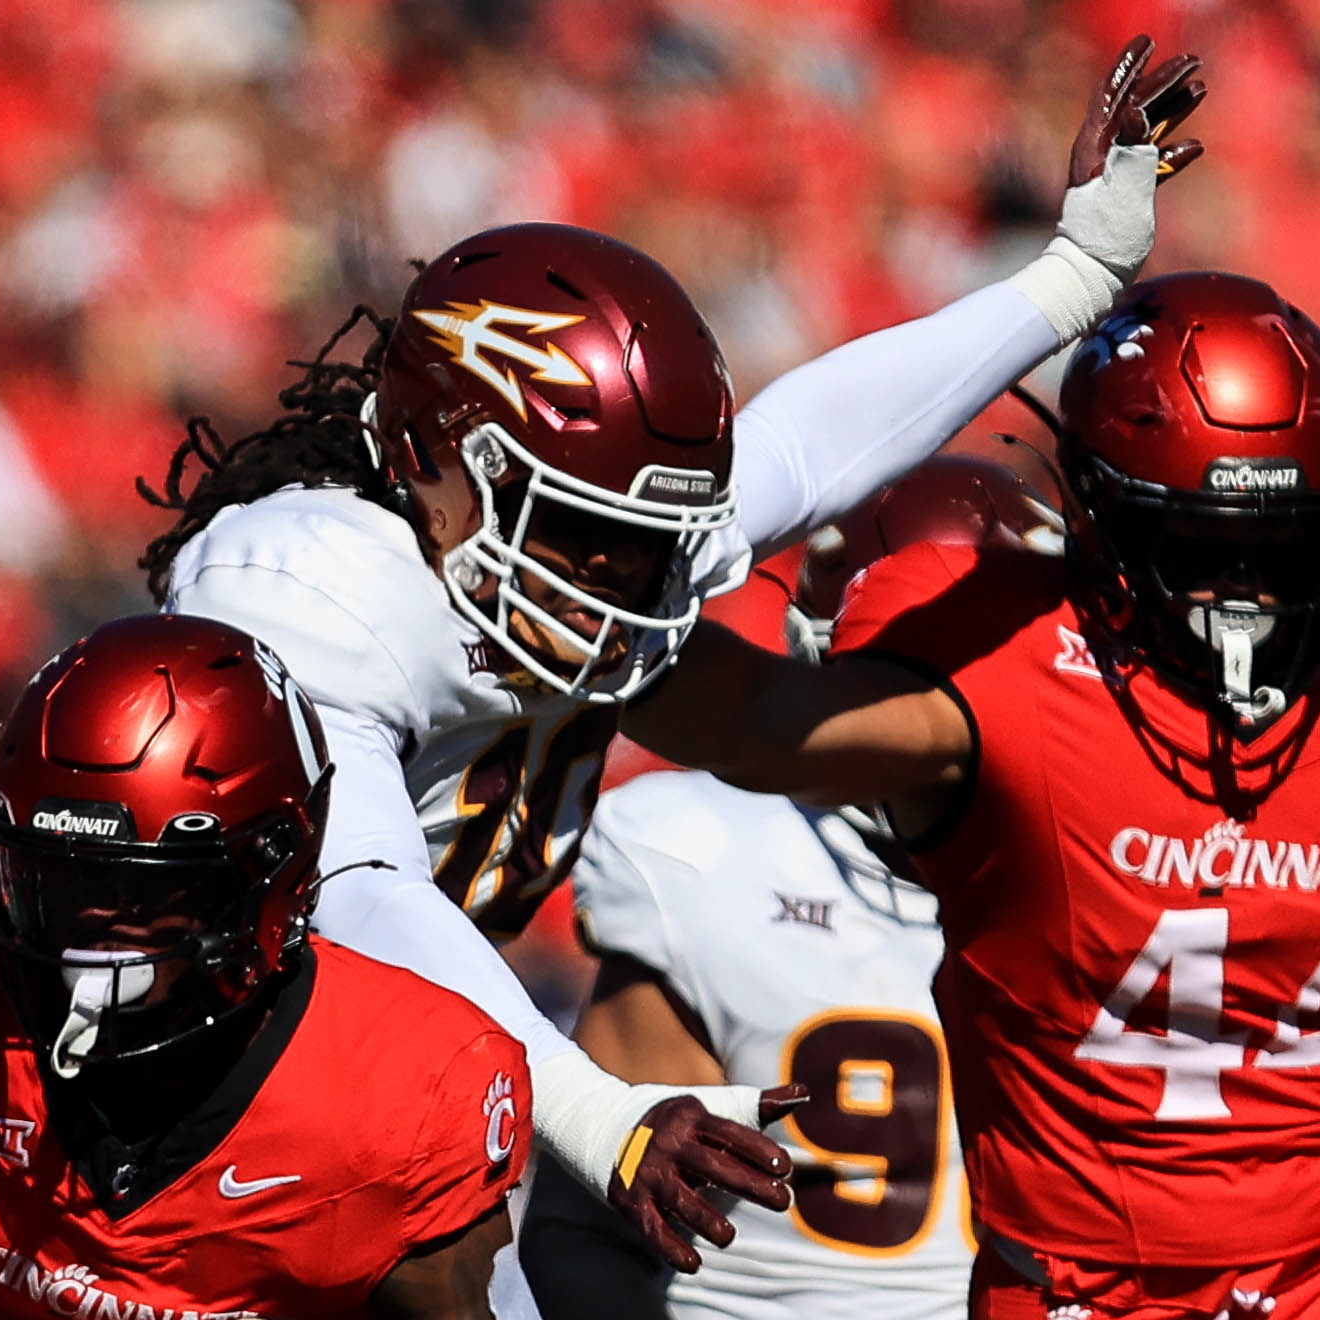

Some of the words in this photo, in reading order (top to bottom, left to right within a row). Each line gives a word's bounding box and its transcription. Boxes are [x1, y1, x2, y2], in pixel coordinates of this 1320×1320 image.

[649, 474, 689, 491] ARIZONA
[690, 480, 713, 493] STATE
[1210, 465, 1298, 490] CINCINNATI
[33, 809, 119, 837] CINCINNATI
[779, 1007, 979, 1258] 9
